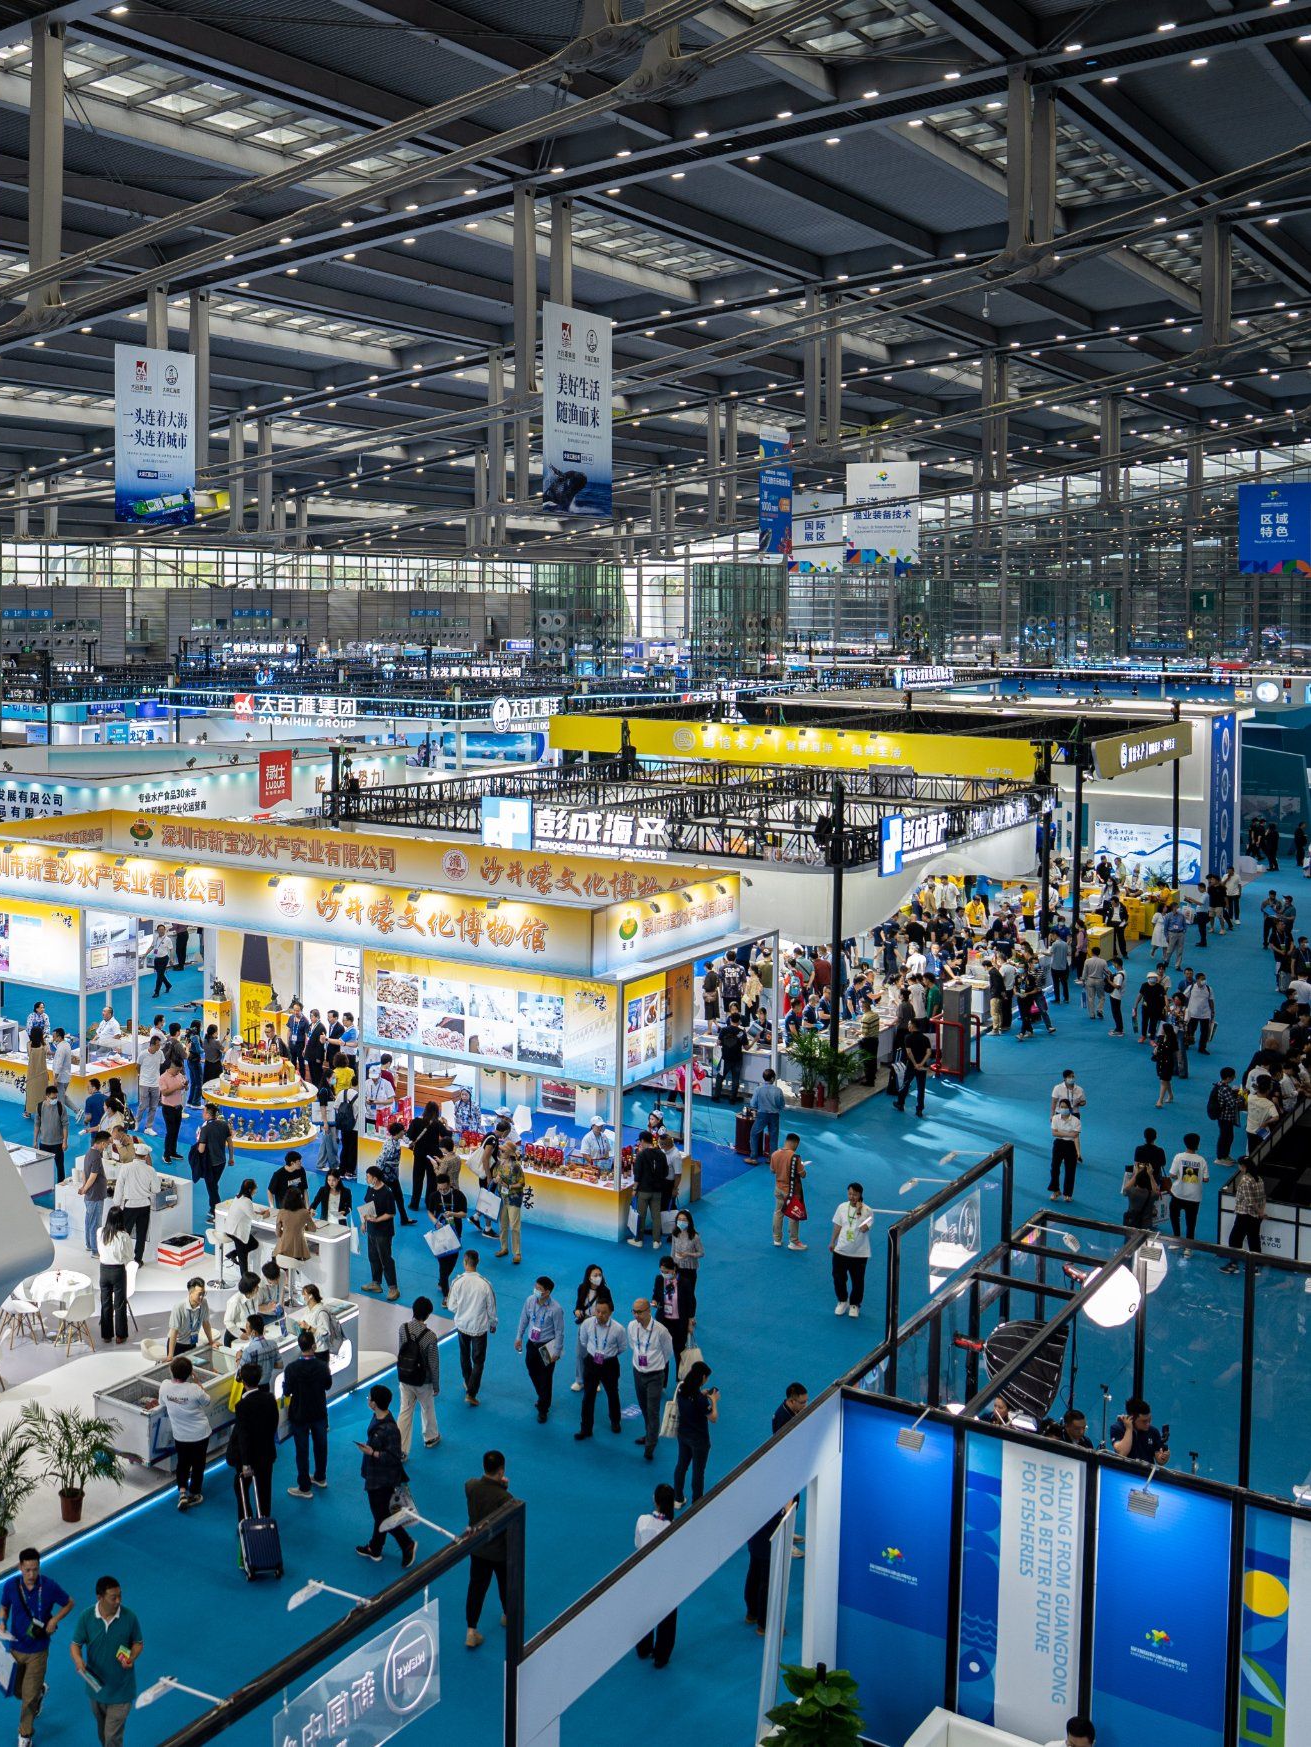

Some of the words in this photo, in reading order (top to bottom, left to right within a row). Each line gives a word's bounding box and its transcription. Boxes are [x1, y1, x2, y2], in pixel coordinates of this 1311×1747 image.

[557, 372, 600, 401] 美好生活
[123, 408, 188, 429] 一头连着大海
[556, 400, 600, 429] 随渔而来
[123, 429, 188, 449] 一头连着城市
[805, 521, 825, 530] 国际
[853, 509, 912, 520] 渔业装备技术
[1260, 513, 1288, 525] 区域
[805, 532, 825, 541] 展区
[1260, 526, 1288, 538] 特色
[259, 717, 312, 727] DABAIHUI
[317, 718, 356, 729] GROUP
[138, 788, 197, 804] 专业水产食品30余年
[161, 824, 397, 872] 深圳市新宝沙水产实业有限公司
[621, 847, 667, 860] PRODUCTS
[1022, 1460, 1037, 1493] FOR
[1040, 1464, 1055, 1507] INTO
[1058, 1469, 1074, 1536] SAILING
[1040, 1511, 1054, 1522] A
[1020, 1498, 1036, 1578] FISHERIES
[1038, 1528, 1053, 1587] BETTER
[1056, 1539, 1072, 1589] FROM
[1035, 1590, 1052, 1654] FUTURE
[1052, 1595, 1070, 1705] GUANGDONG
